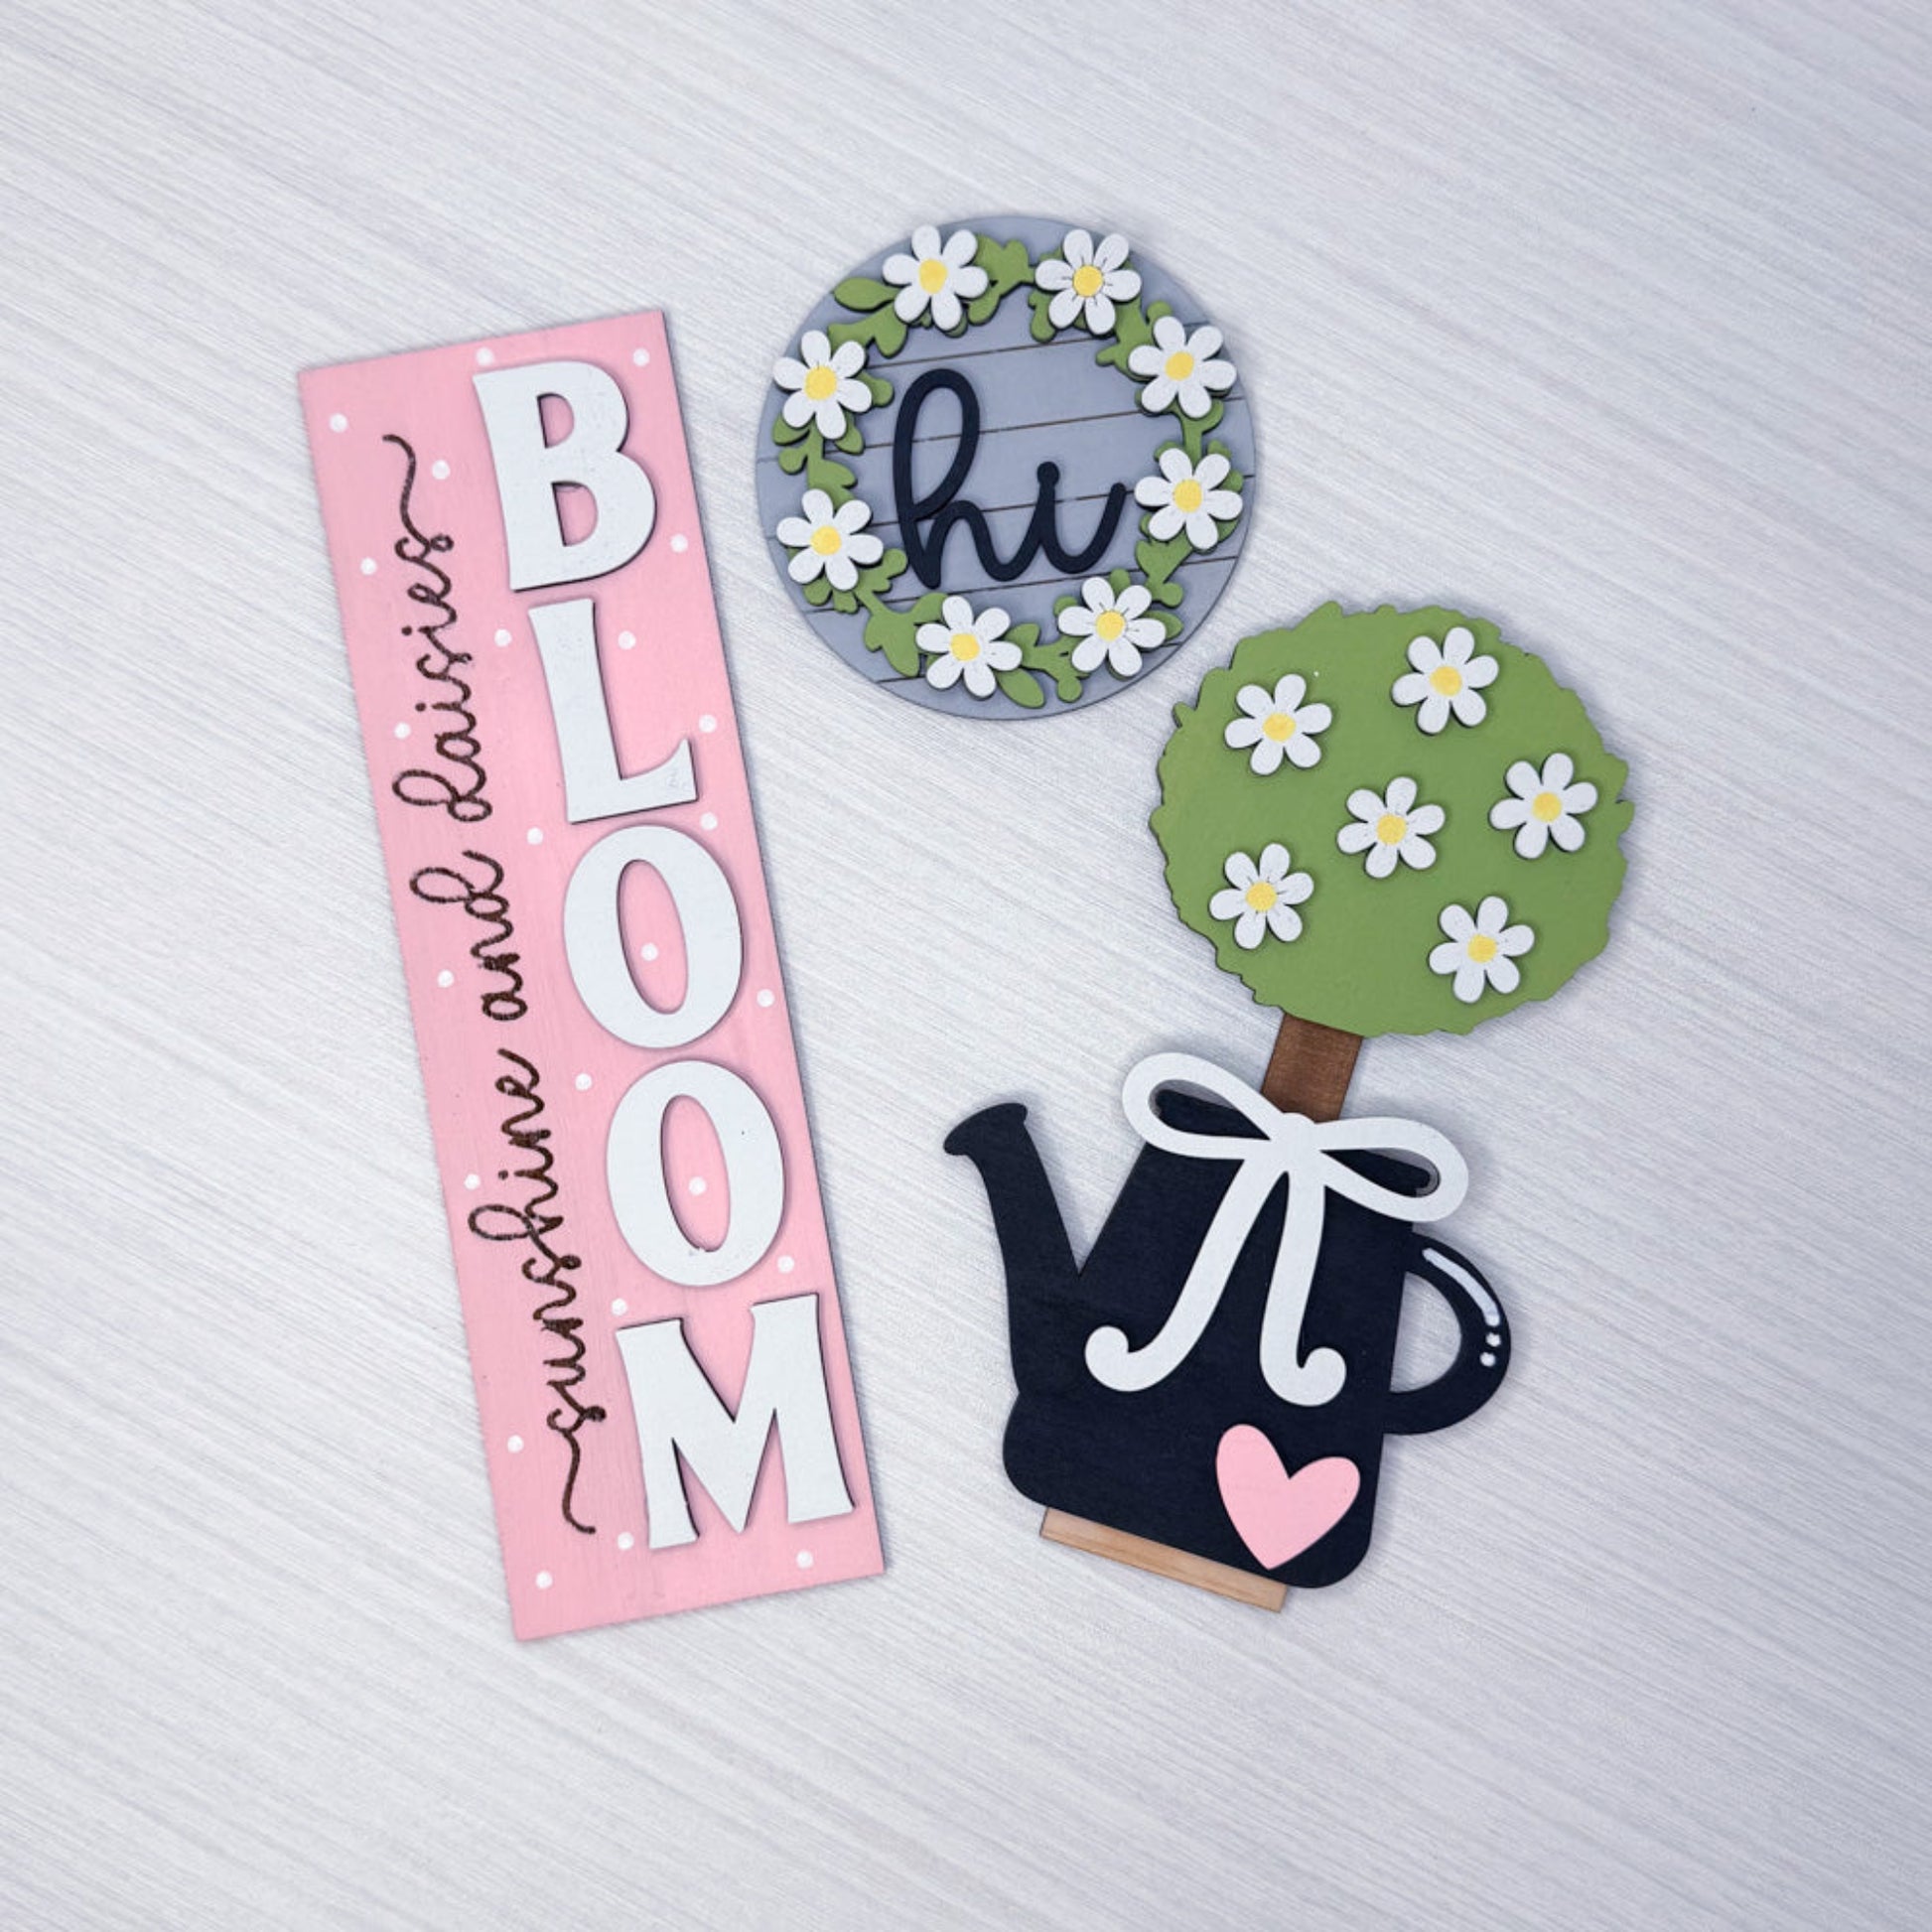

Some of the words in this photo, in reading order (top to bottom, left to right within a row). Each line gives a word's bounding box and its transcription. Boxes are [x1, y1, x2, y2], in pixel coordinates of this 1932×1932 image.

[381, 433, 492, 823] daisies
[893, 367, 1128, 589] hi
[408, 849, 528, 1022] and
[472, 359, 857, 1550] BLOOM
[467, 1047, 608, 1535] sunshine
